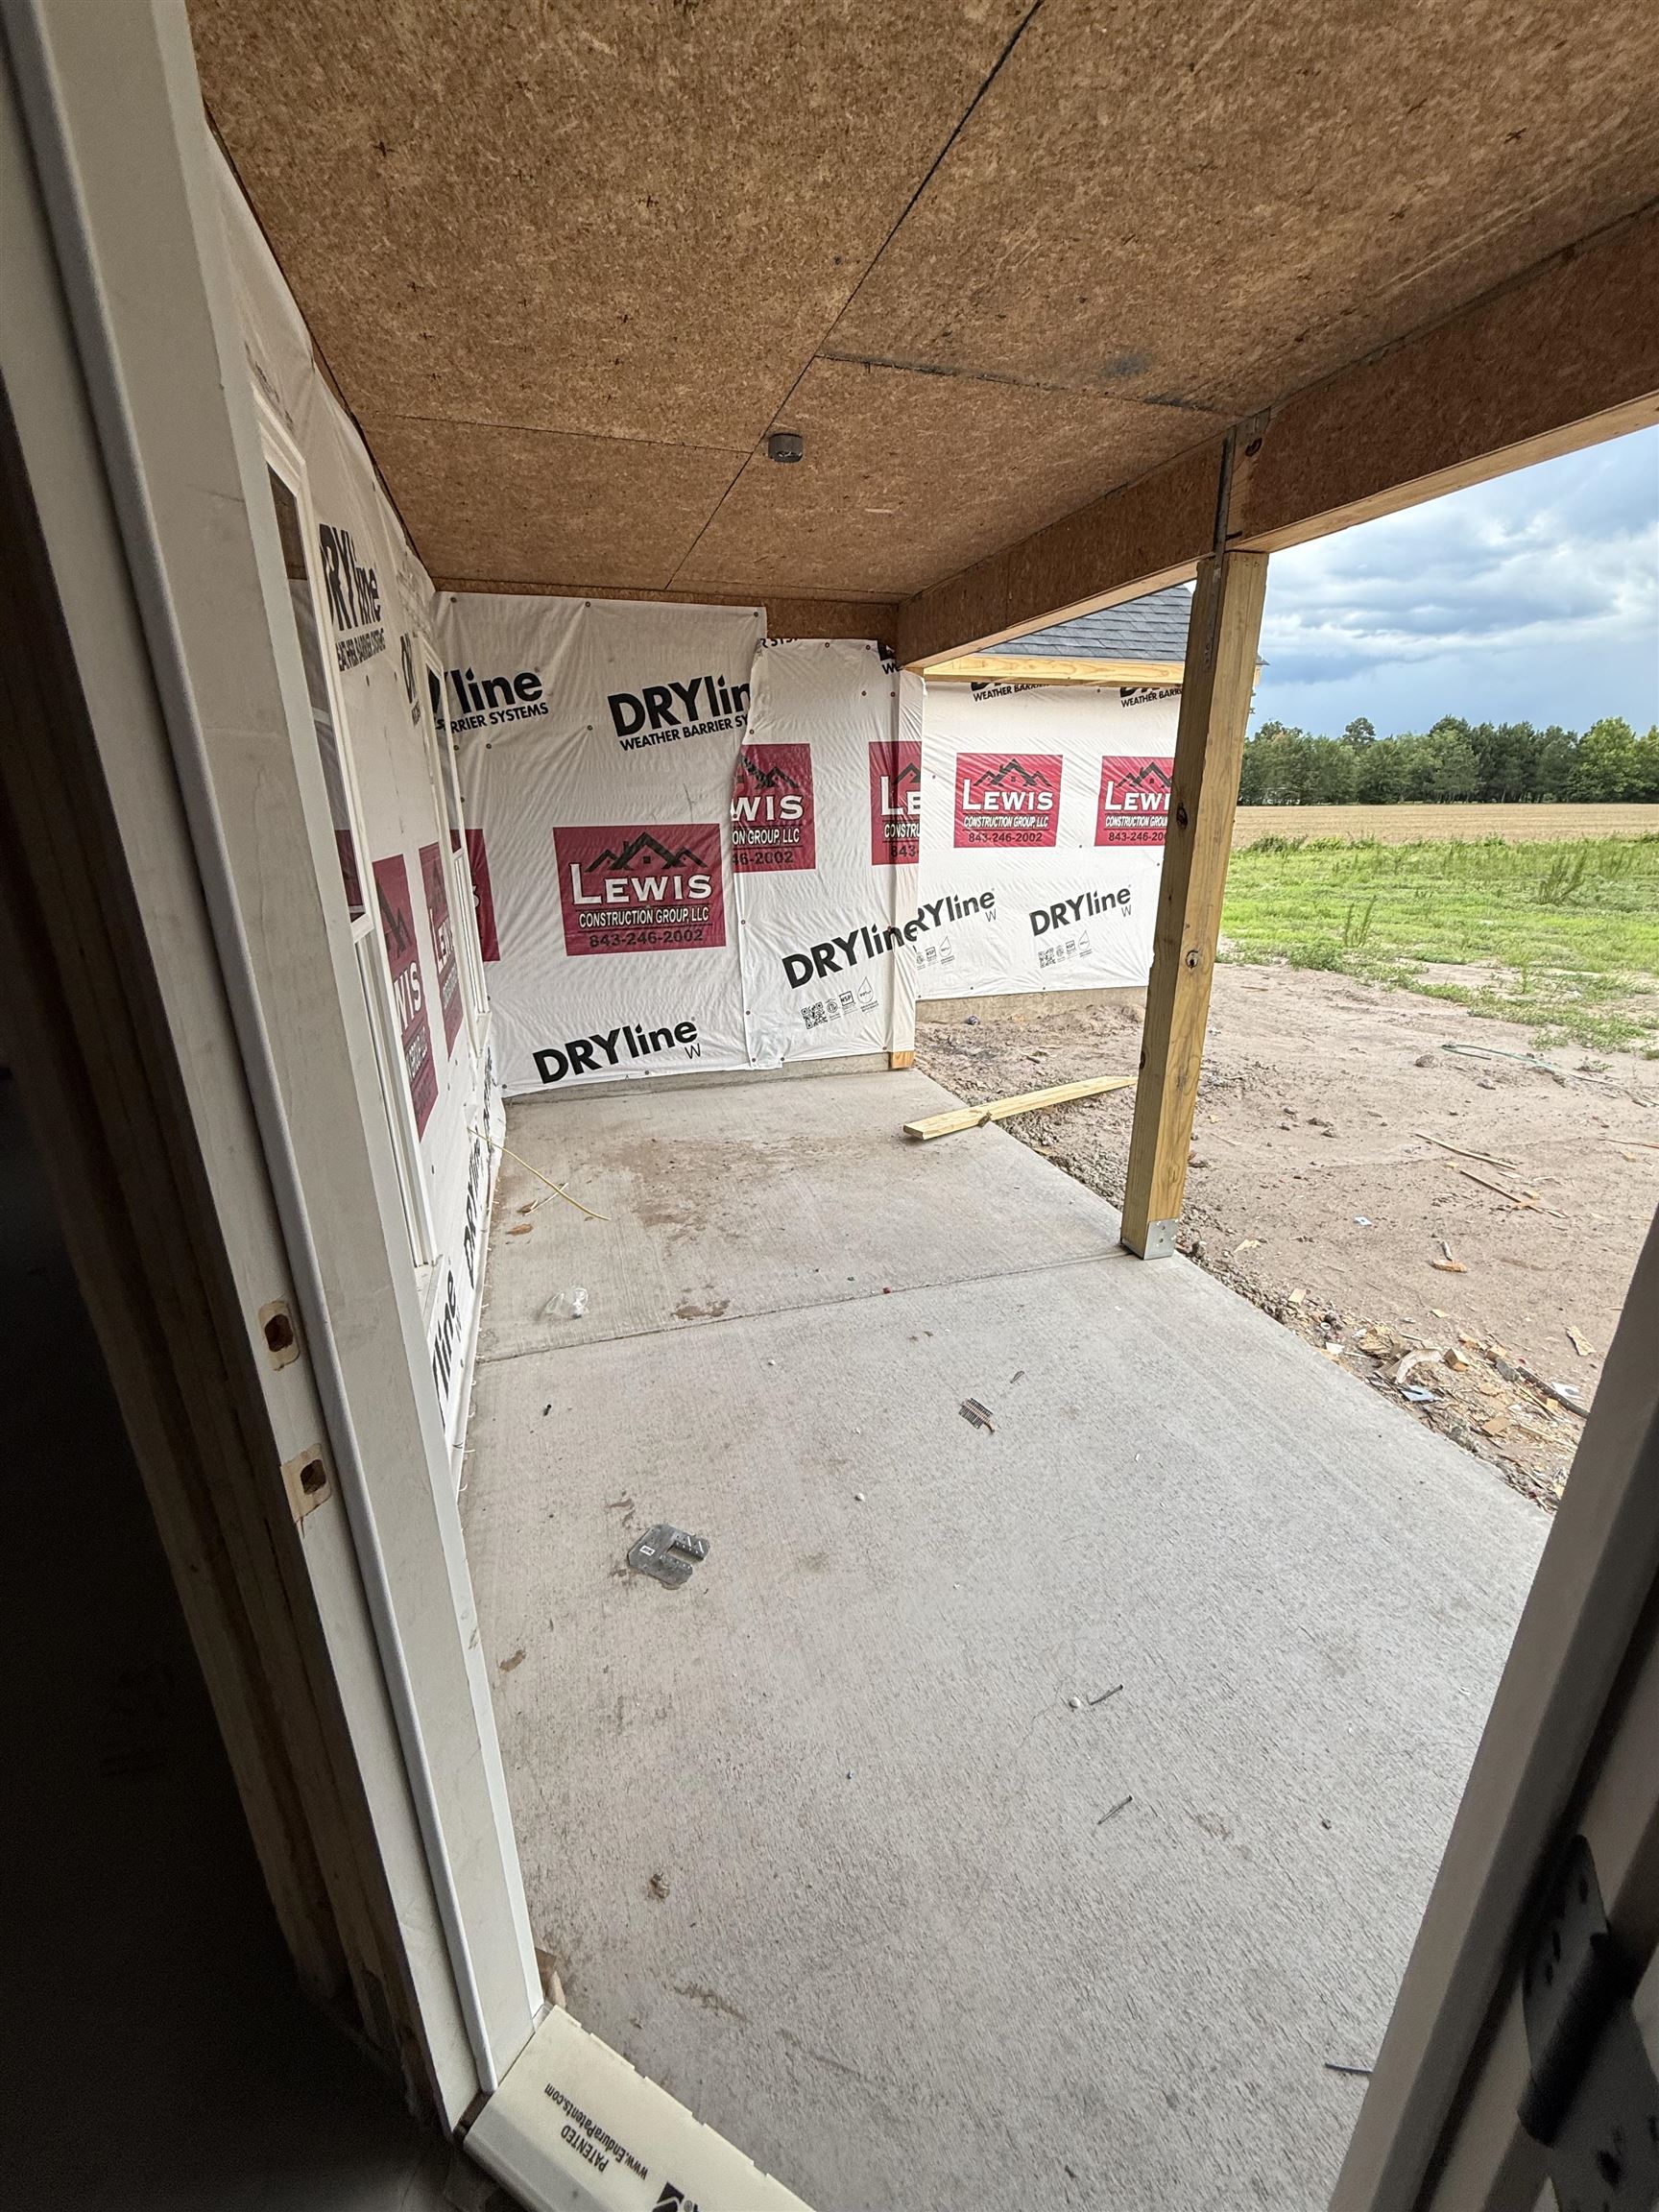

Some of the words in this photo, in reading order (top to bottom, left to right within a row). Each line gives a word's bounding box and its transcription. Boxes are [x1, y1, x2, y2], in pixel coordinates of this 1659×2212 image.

[973, 685, 1013, 702] WEATHER
[1120, 691, 1158, 708] WEATHER
[489, 702, 549, 725] SYSTEMS
[619, 730, 682, 751] WEATHER
[683, 717, 733, 738] BARRIER
[962, 779, 1053, 811] LEWIS
[964, 815, 1012, 829] CONSTRUCTION
[1013, 816, 1037, 830] GROUP,
[1037, 816, 1048, 829] LLC
[1105, 815, 1150, 828] CONSTRUCTION
[747, 829, 781, 846] GROUP,
[782, 828, 801, 843] LLC
[968, 832, 1044, 843] 843-246-2002
[570, 863, 712, 905] LEWIS
[579, 909, 654, 927] CONSTRUCTION
[655, 908, 690, 925] GROUP,
[691, 906, 709, 922] LLC
[985, 908, 997, 923] W
[1029, 888, 1132, 937] DRYline
[1121, 903, 1132, 918] W
[589, 928, 703, 948] 843-246-2002
[781, 924, 918, 990] DRYline
[533, 1022, 698, 1084] DRYline
[685, 1043, 702, 1060] W
[544, 2083, 649, 2180] www.EnduraPatents.com
[561, 2125, 609, 2173] PATENTED
